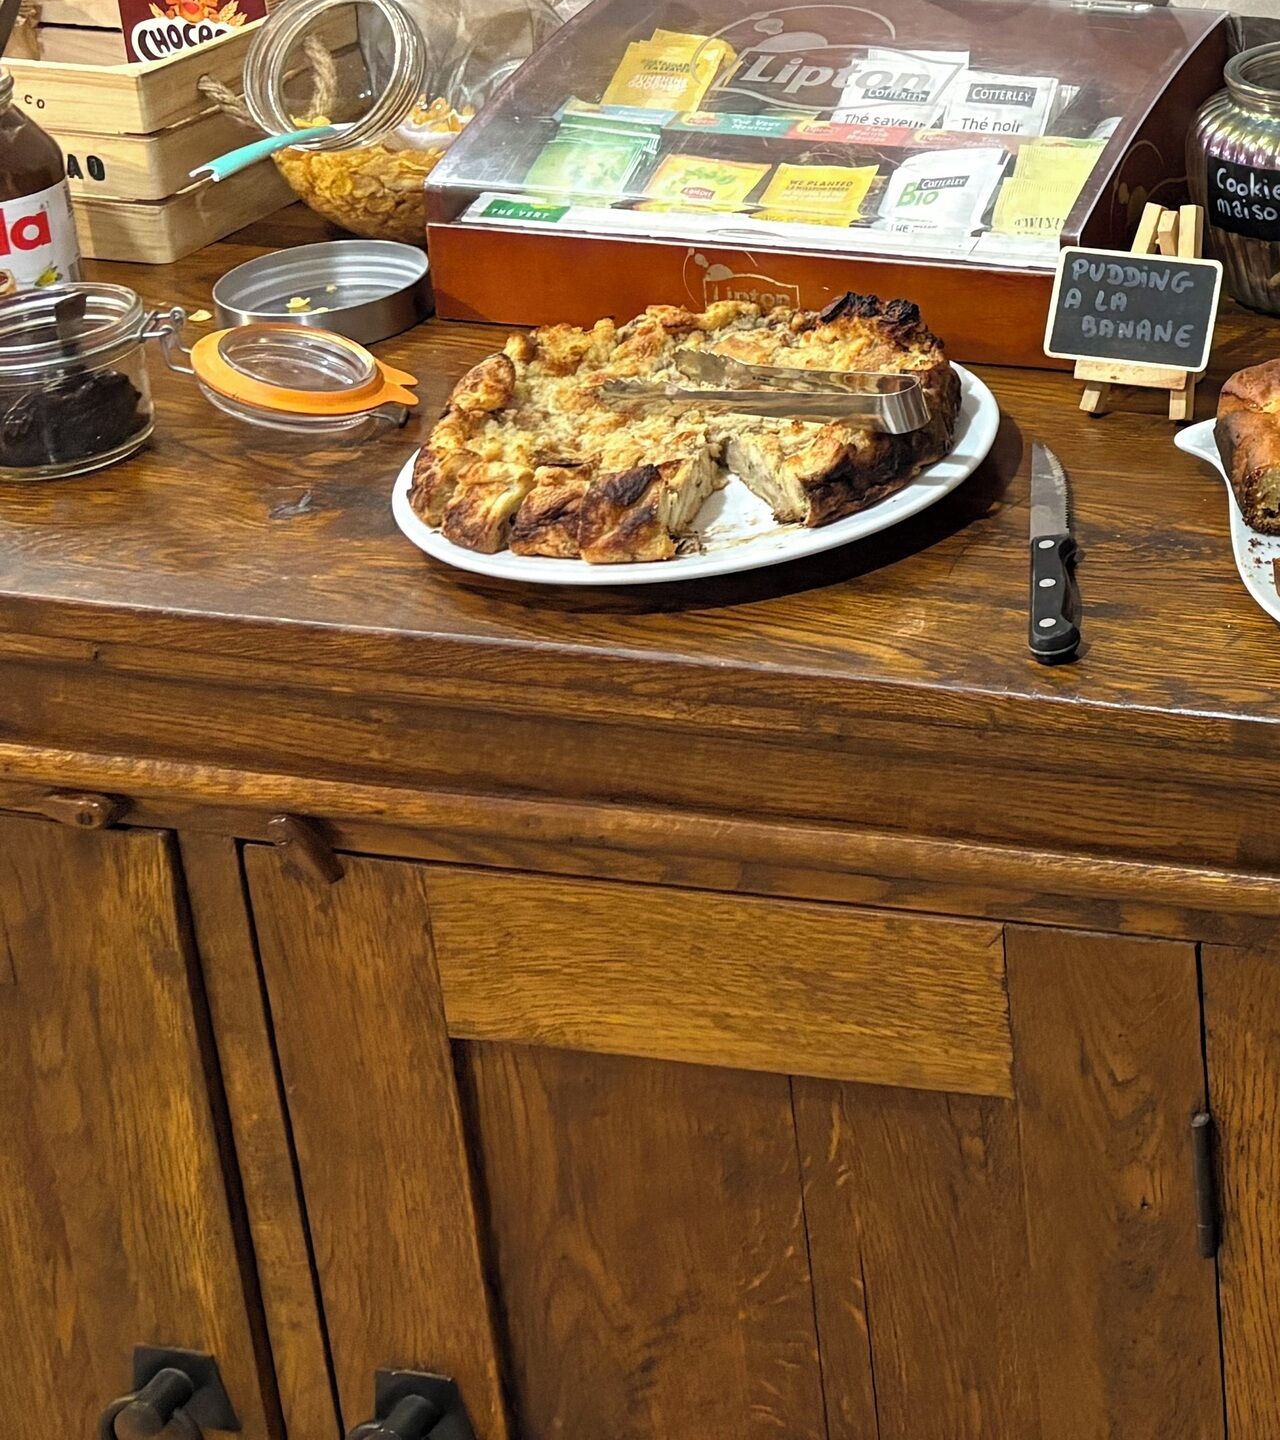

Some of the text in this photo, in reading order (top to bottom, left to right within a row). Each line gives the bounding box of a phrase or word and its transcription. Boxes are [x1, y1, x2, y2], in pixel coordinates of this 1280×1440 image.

[740, 55, 930, 93] Lipton
[961, 117, 1024, 133] Thé noir
[1064, 288, 1128, 311] A LA
[1082, 315, 1194, 348] BANANE
